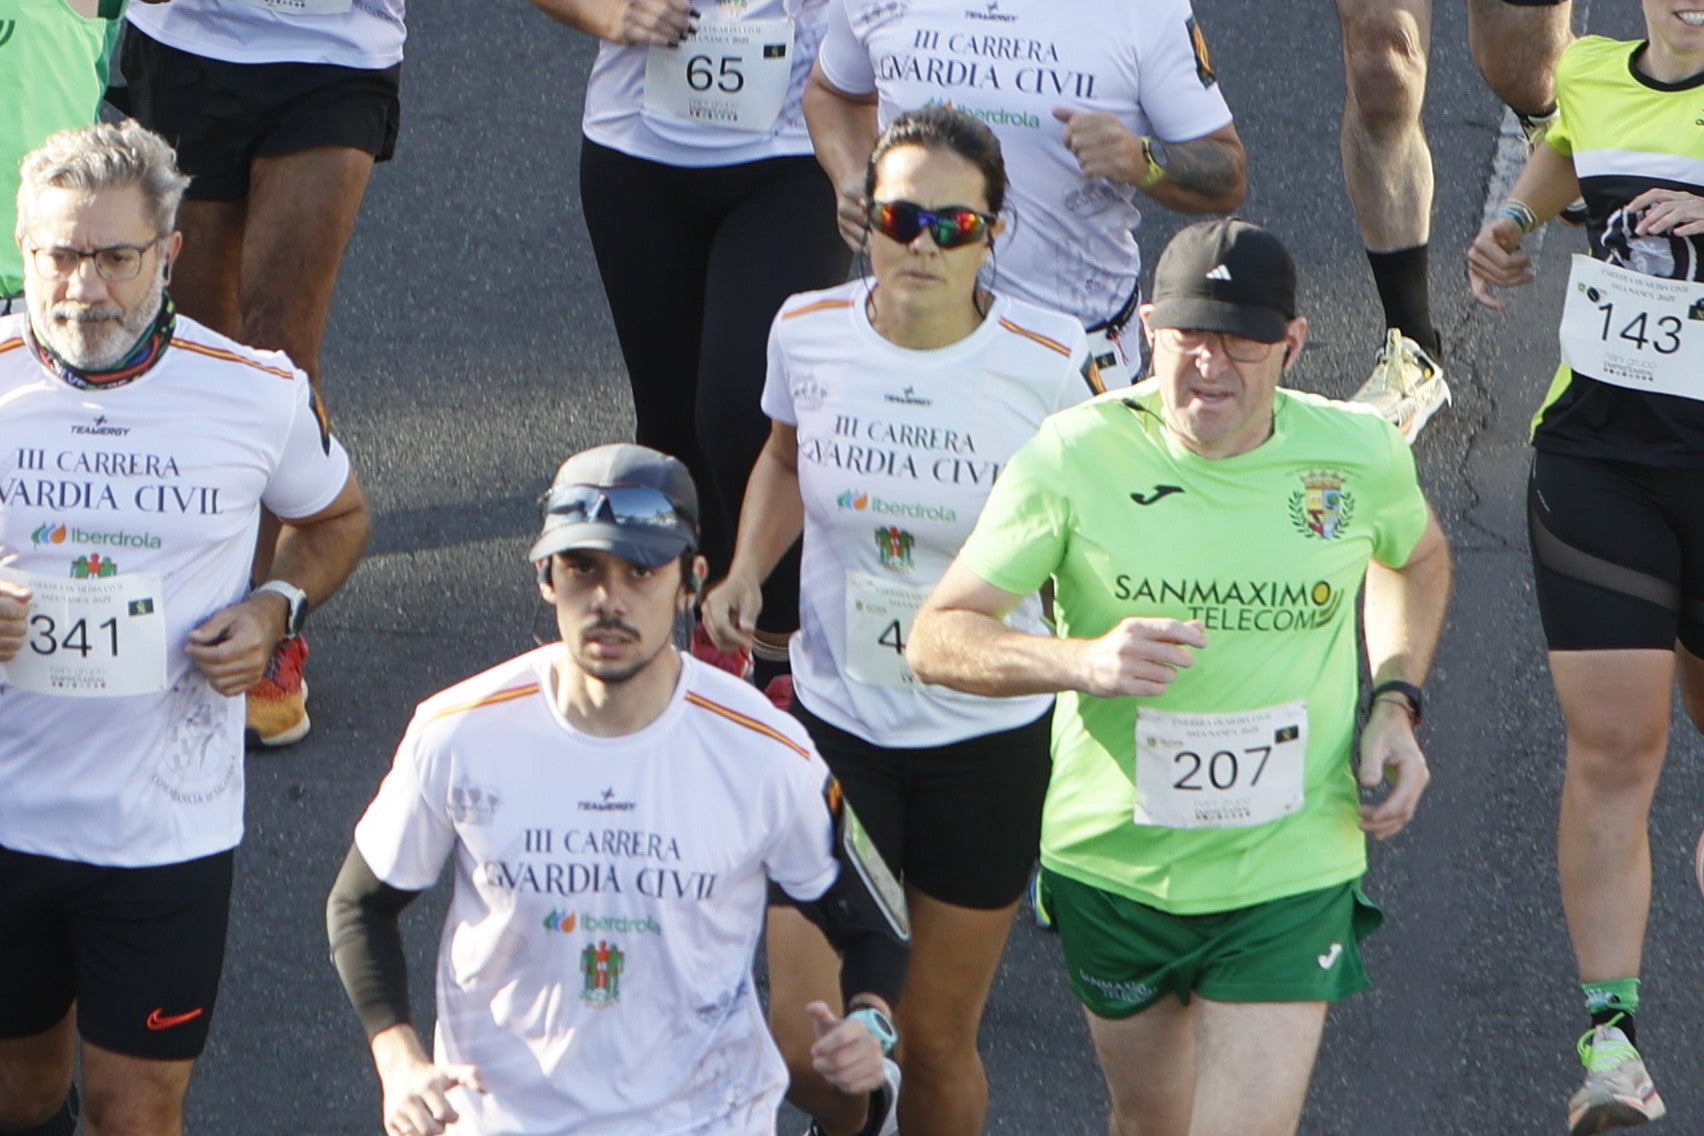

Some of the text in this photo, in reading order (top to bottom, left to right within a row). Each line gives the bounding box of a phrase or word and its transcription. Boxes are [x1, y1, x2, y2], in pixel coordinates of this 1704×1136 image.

[914, 29, 1060, 63] III CARRERA
[686, 54, 745, 94] 65
[878, 56, 1098, 100] GVARDIA CIVIL
[1598, 303, 1683, 355] 143
[835, 415, 976, 454] III CARRERA
[17, 448, 181, 479] III CARRERA
[933, 458, 1004, 486] CIVI
[134, 484, 223, 515] CIVIL
[1114, 574, 1332, 607] SANMAXIMO
[30, 614, 118, 658] 341
[1188, 606, 1317, 632] TELECOM
[1173, 745, 1272, 791] 207
[525, 828, 682, 862] III CARRERA
